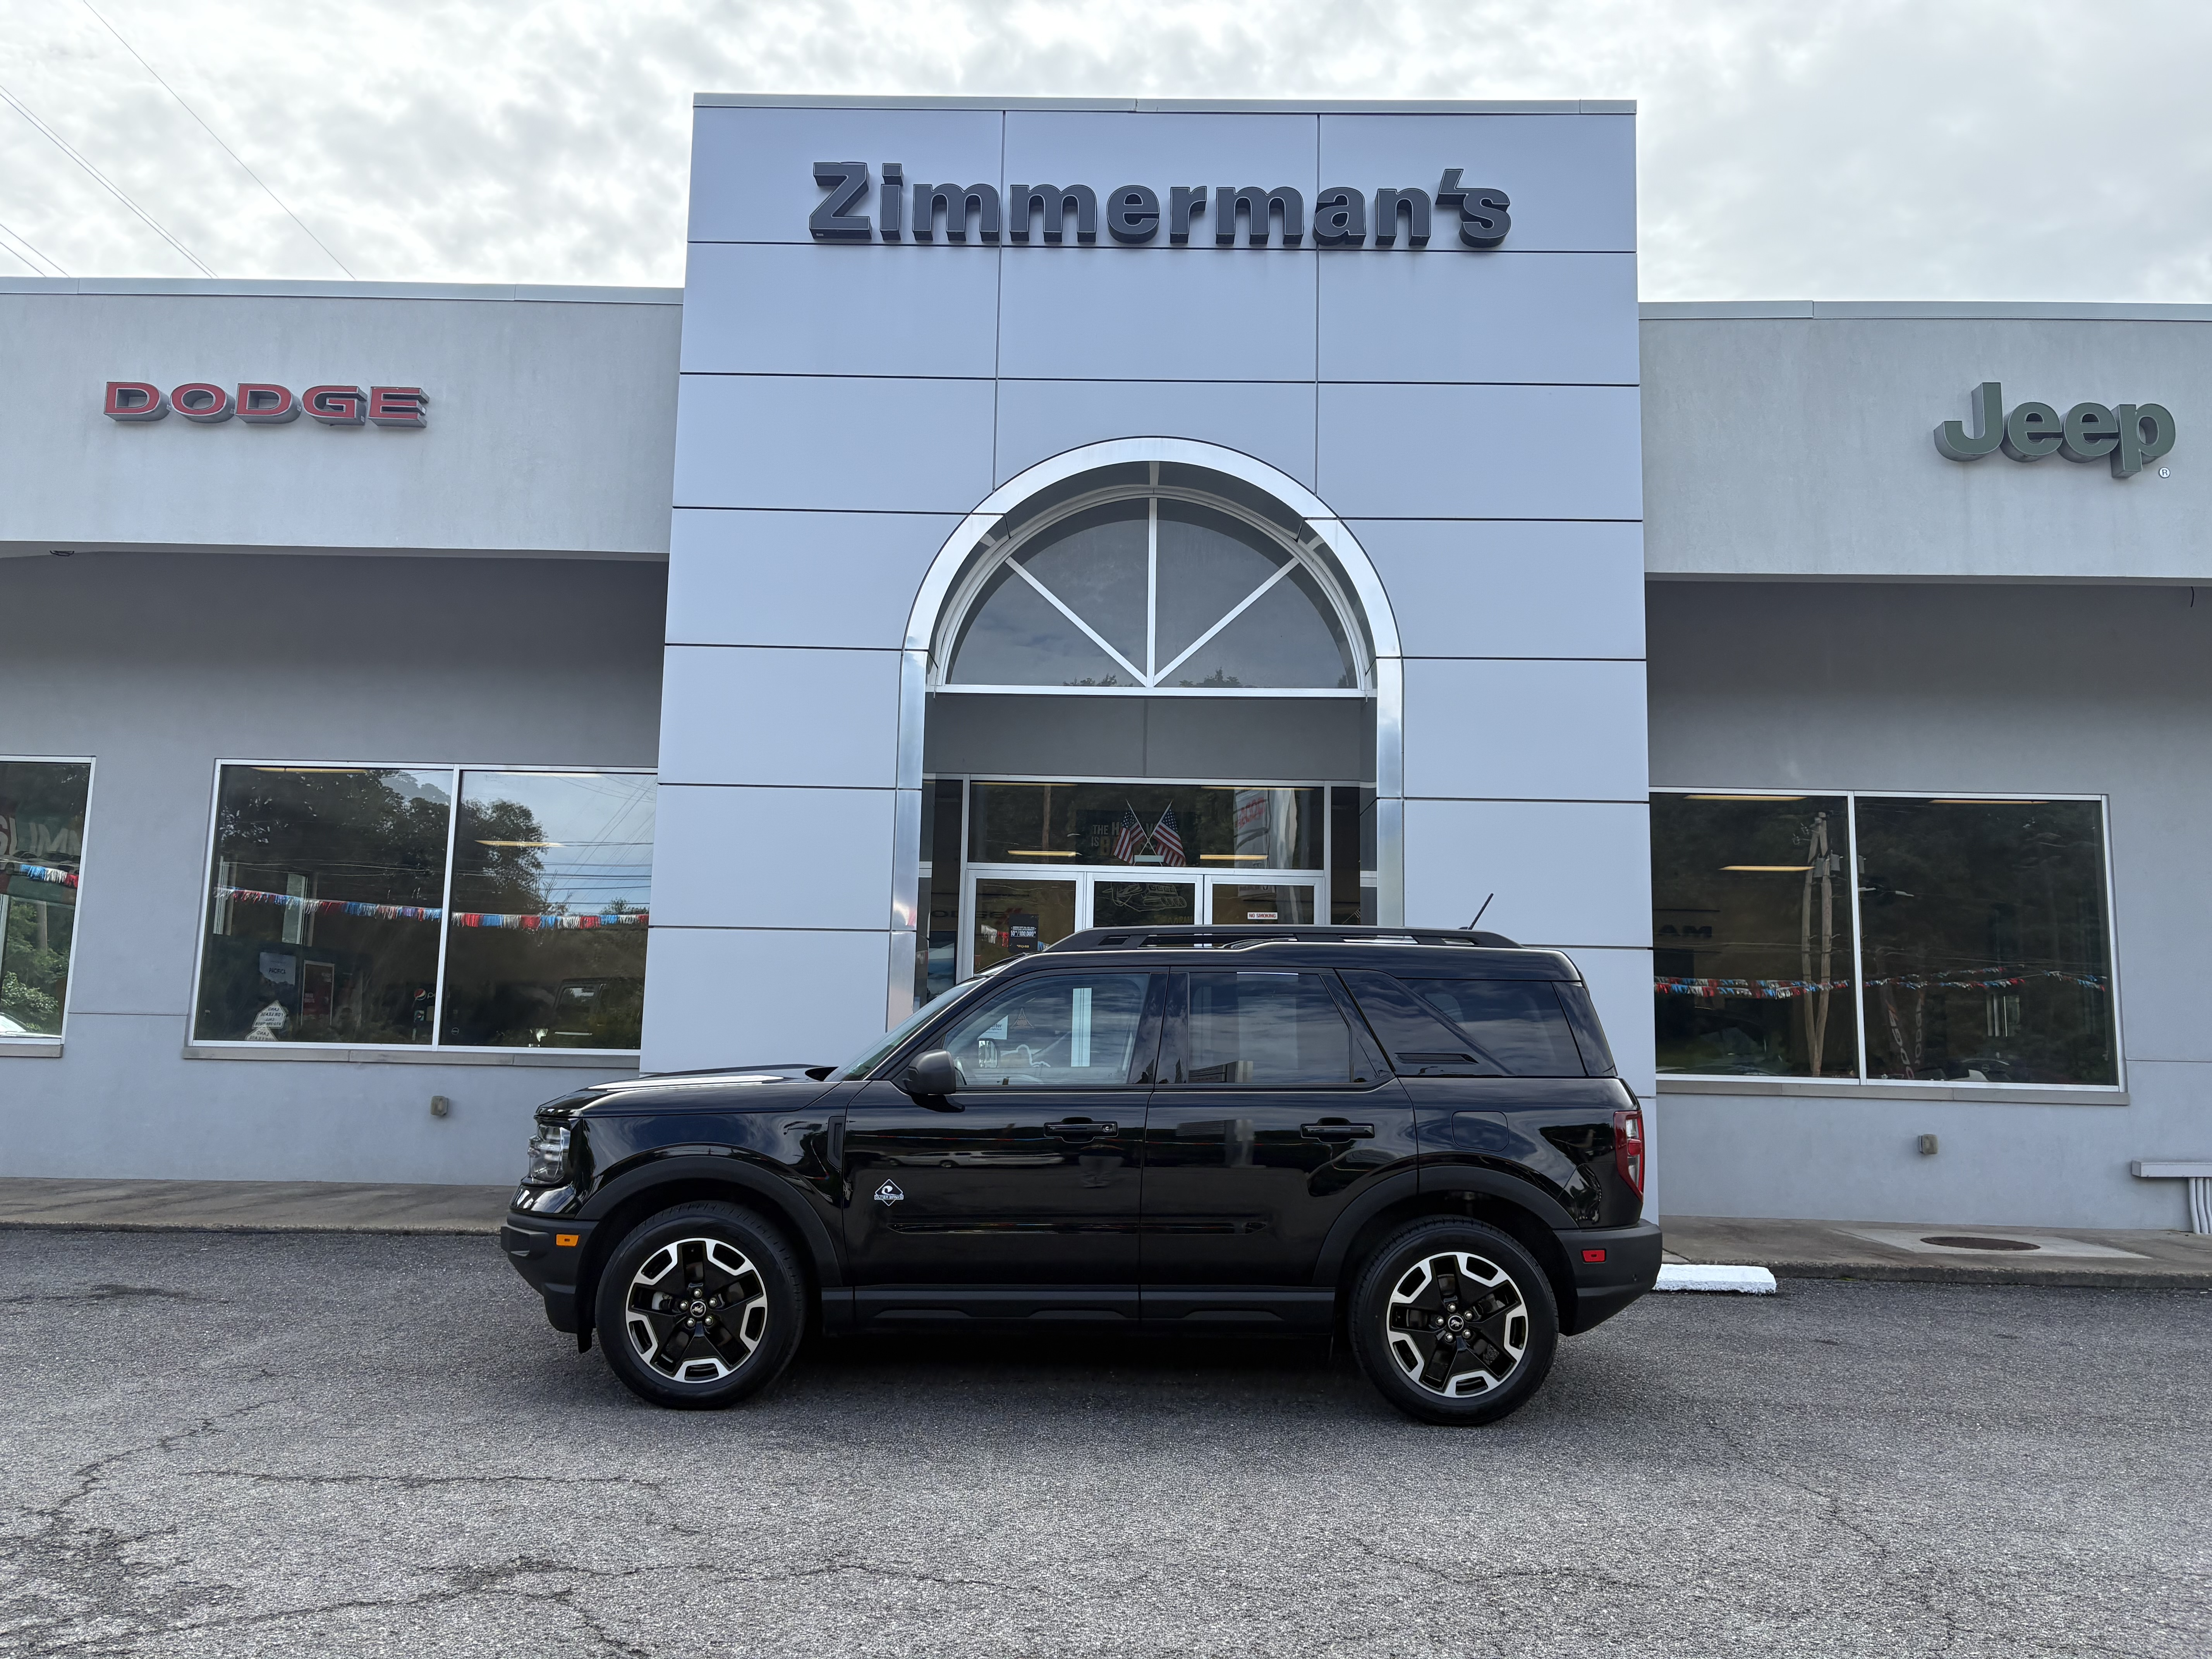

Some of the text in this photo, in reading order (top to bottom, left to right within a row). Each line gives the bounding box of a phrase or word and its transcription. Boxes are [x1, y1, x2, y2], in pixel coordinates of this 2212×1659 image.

[809, 161, 1511, 247] Zimmerman's
[103, 381, 429, 427] DODGE
[1934, 382, 2176, 478] Jeep
[1091, 836, 1099, 847] IS
[1092, 824, 1109, 835] THE
